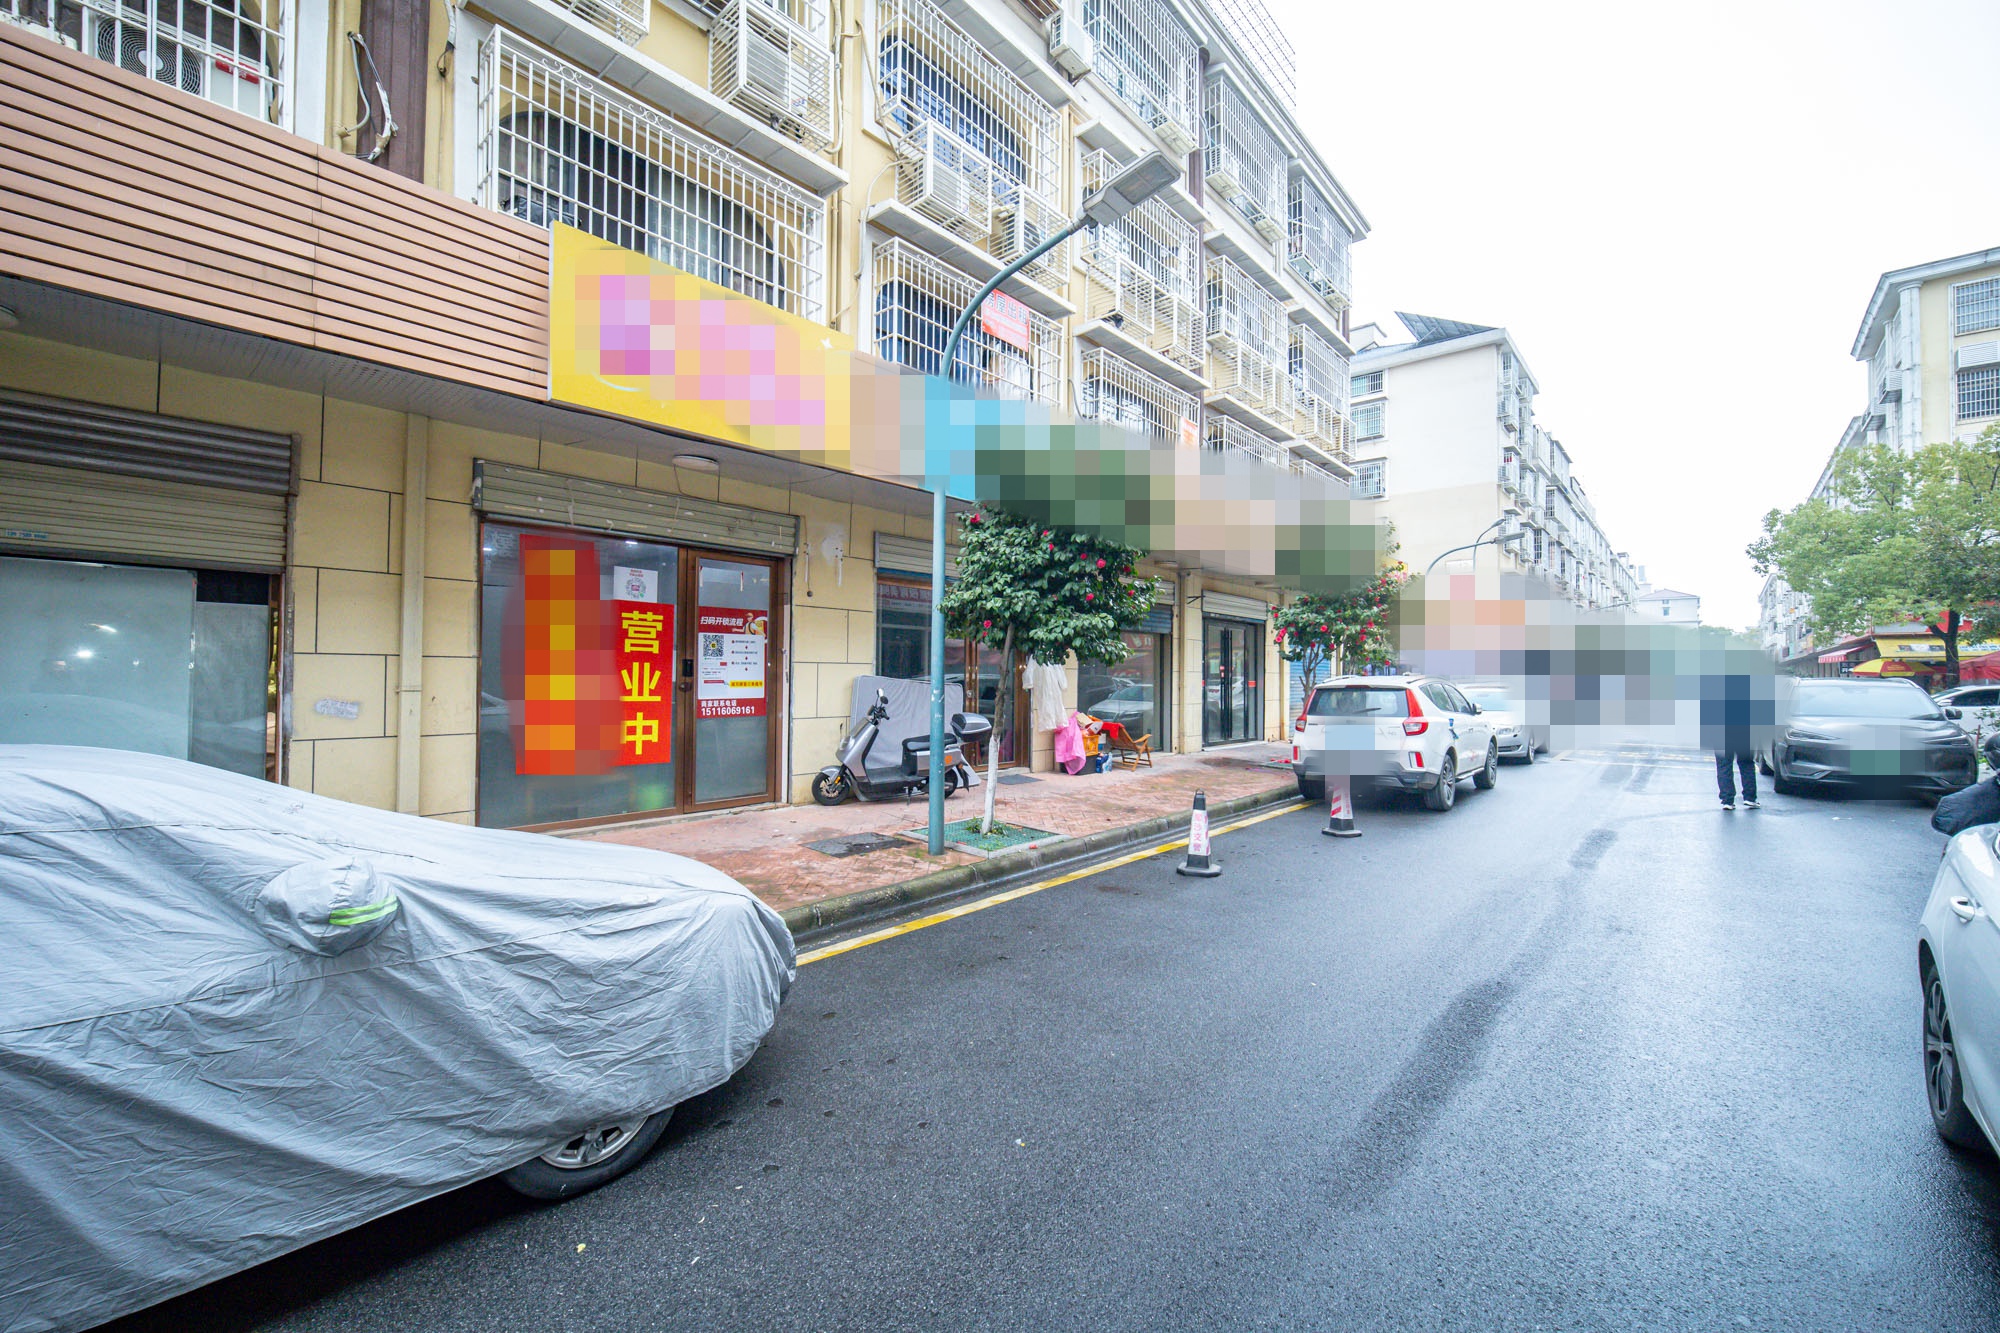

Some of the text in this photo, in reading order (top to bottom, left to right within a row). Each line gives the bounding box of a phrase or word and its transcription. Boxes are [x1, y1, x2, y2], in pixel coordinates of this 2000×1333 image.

[620, 610, 663, 755] 营业中
[701, 706, 755, 716] 15116069161
